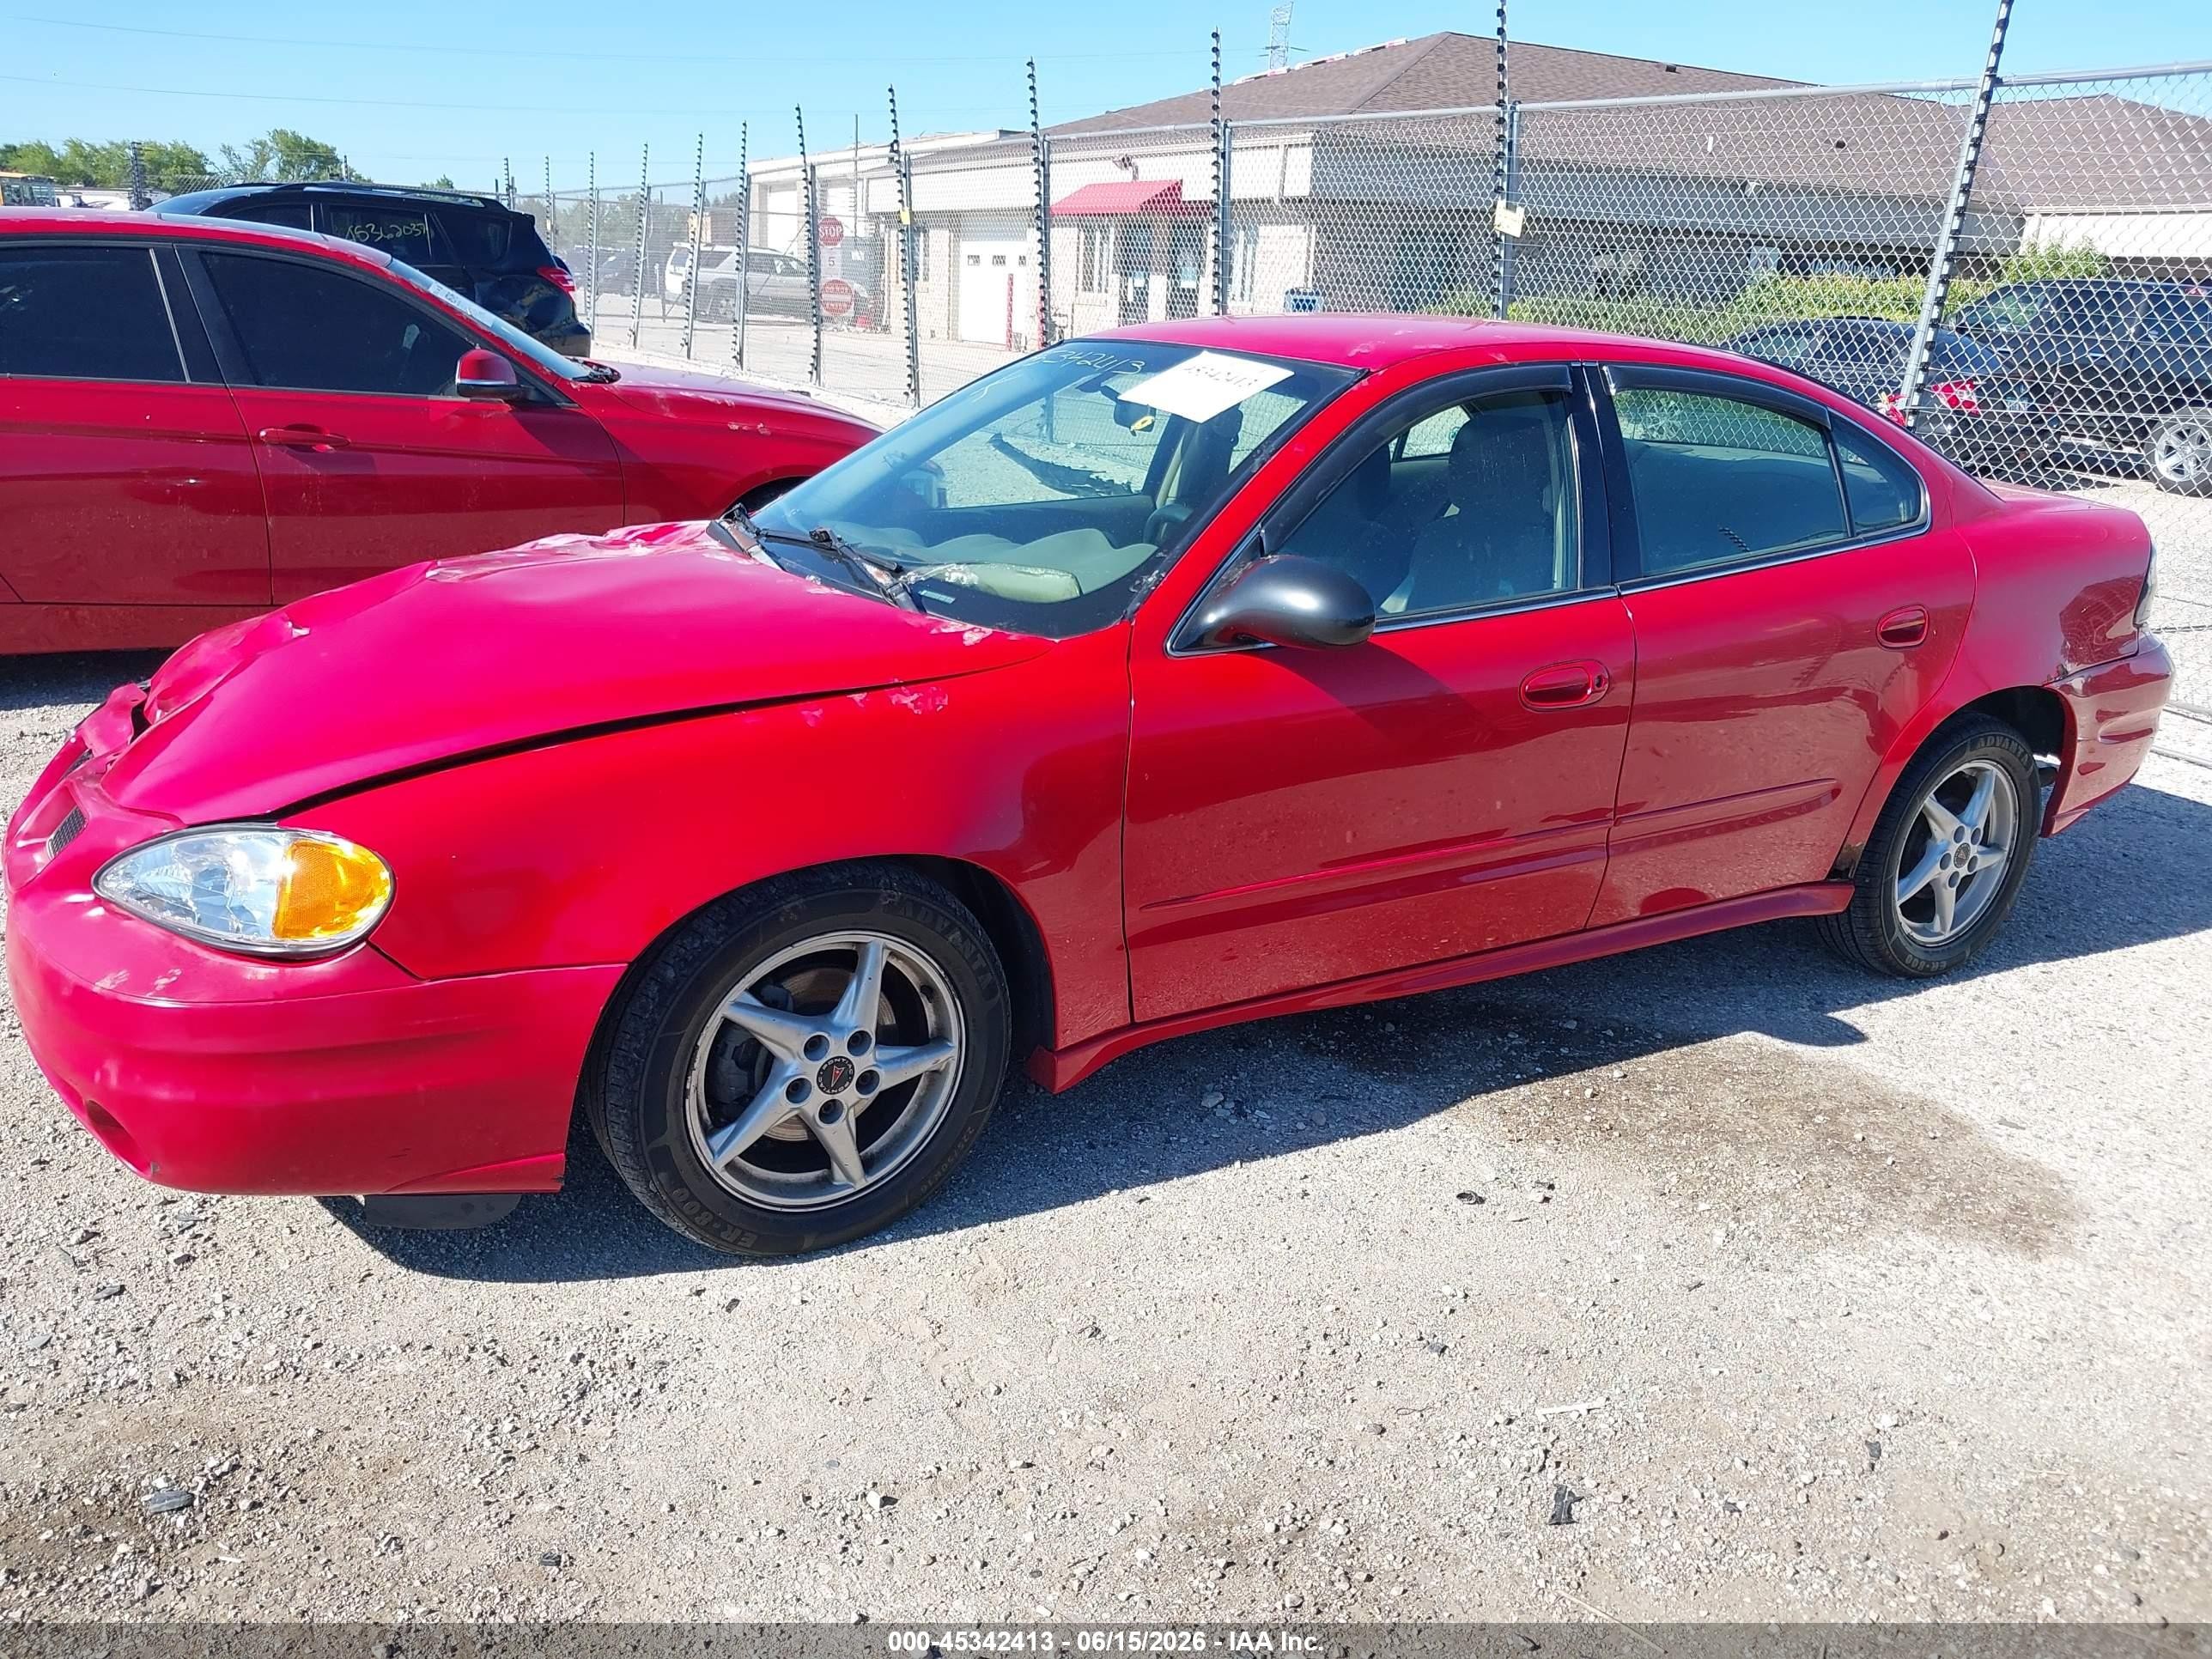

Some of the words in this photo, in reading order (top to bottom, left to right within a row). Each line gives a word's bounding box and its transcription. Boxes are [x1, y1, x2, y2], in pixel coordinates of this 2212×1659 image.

[818, 227, 842, 238] STOP
[828, 256, 836, 267] 5
[822, 1058, 854, 1075] PONTIAC
[818, 1077, 850, 1094] PONTIAC
